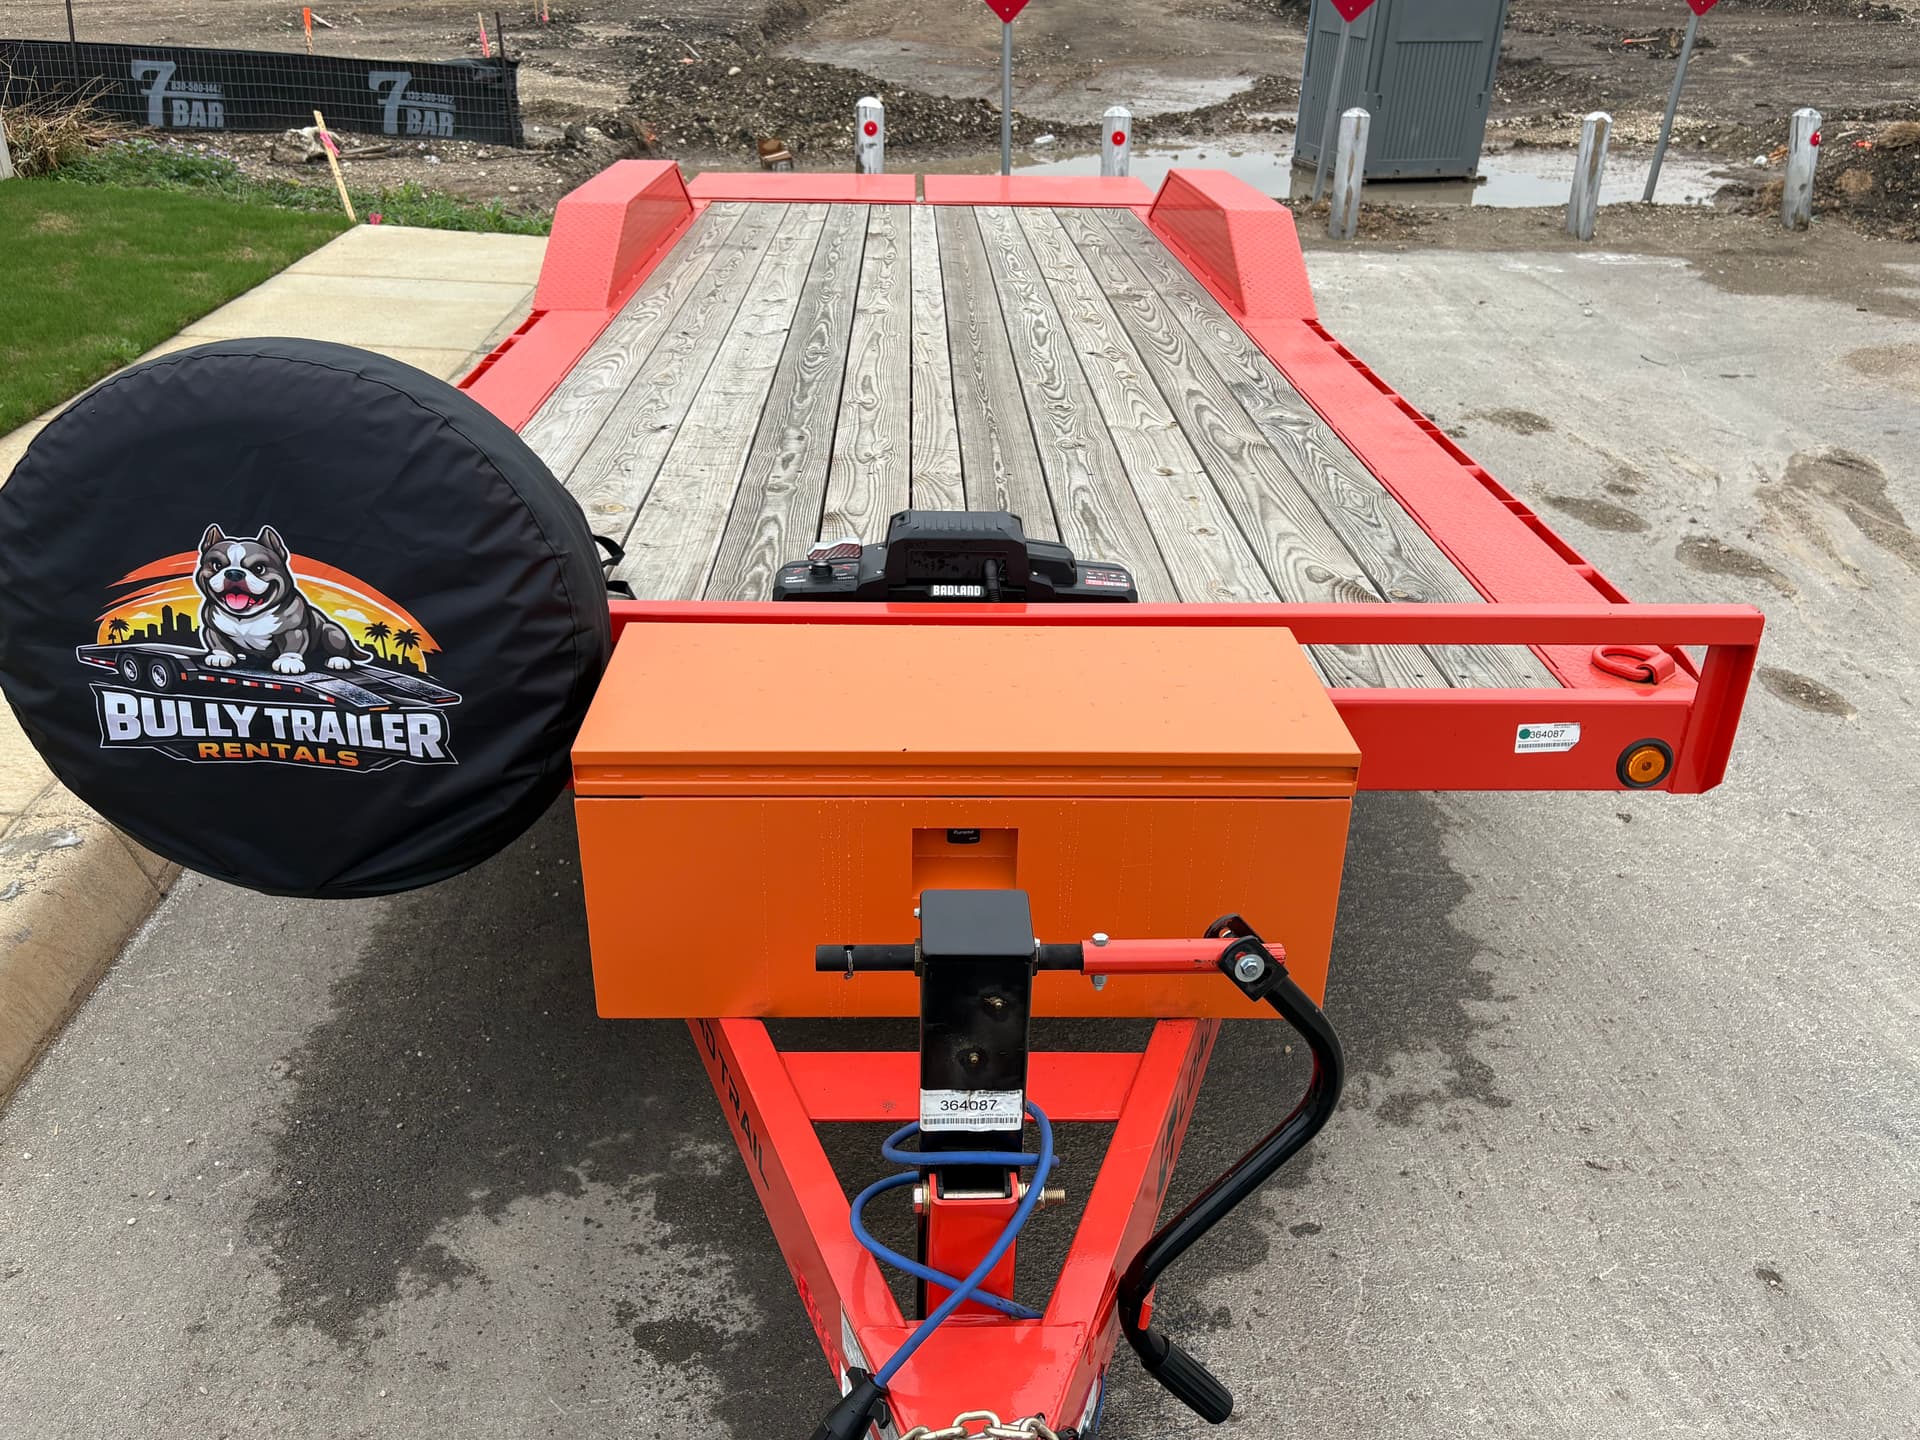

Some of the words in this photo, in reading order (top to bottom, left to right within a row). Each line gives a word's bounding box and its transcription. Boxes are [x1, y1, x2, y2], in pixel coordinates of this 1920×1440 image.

[131, 59, 177, 127] 7
[171, 99, 225, 128] BAR
[368, 71, 412, 134] 7
[406, 107, 454, 137] BAR
[933, 584, 981, 597] BADLAND
[101, 690, 258, 741] BULLY
[263, 707, 446, 759] TRAILER
[1529, 729, 1565, 739] 364087
[197, 742, 360, 767] RENTALS
[940, 1100, 997, 1111] 364087
